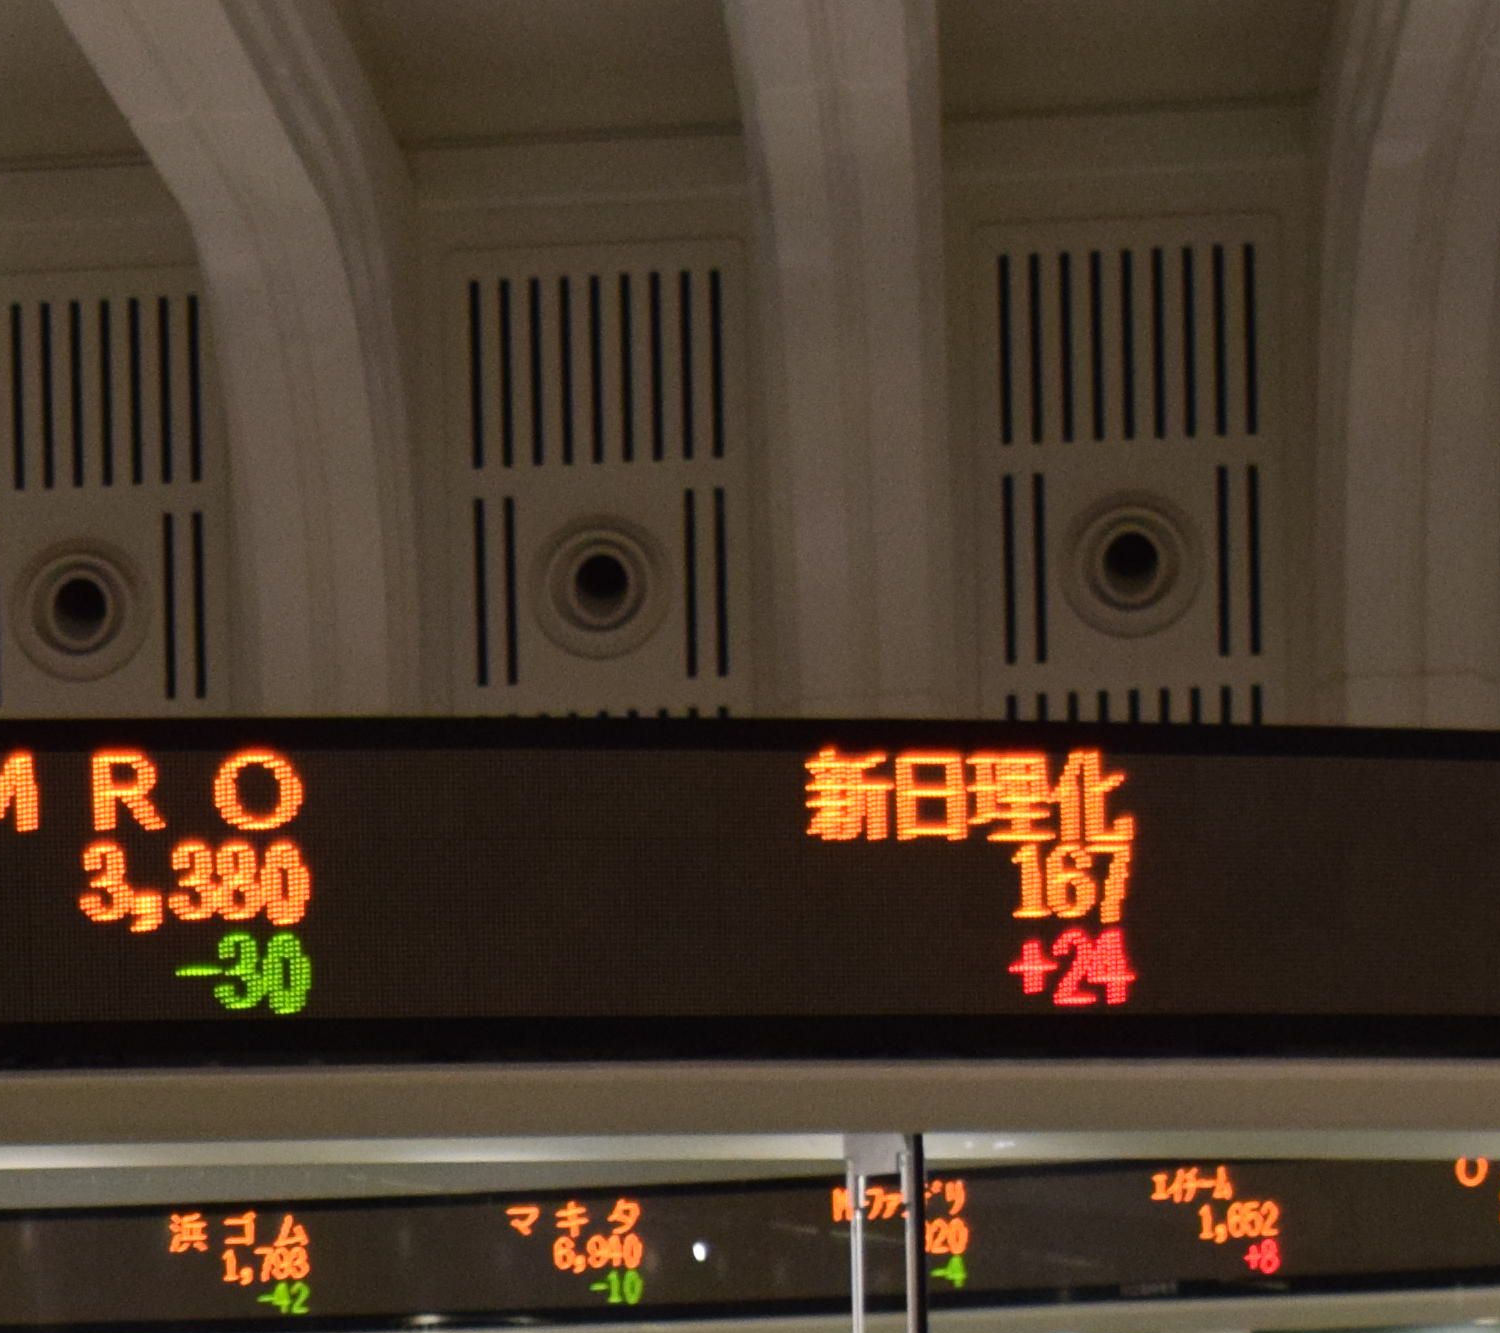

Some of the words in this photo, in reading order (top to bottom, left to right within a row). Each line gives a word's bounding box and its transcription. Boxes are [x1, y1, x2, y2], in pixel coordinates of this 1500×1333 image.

[805, 751, 1134, 841] 新日理化
[80, 841, 310, 932] 3,380
[1012, 843, 1131, 922] 167
[175, 933, 311, 1014] -30
[1009, 930, 1134, 1004] +24
[1199, 1201, 1280, 1244] 1,652
[223, 1247, 309, 1286] 1,793
[553, 1234, 642, 1275] 6,940
[1243, 1239, 1280, 1274] +8
[256, 1282, 310, 1316] -42
[589, 1270, 642, 1305] -10
